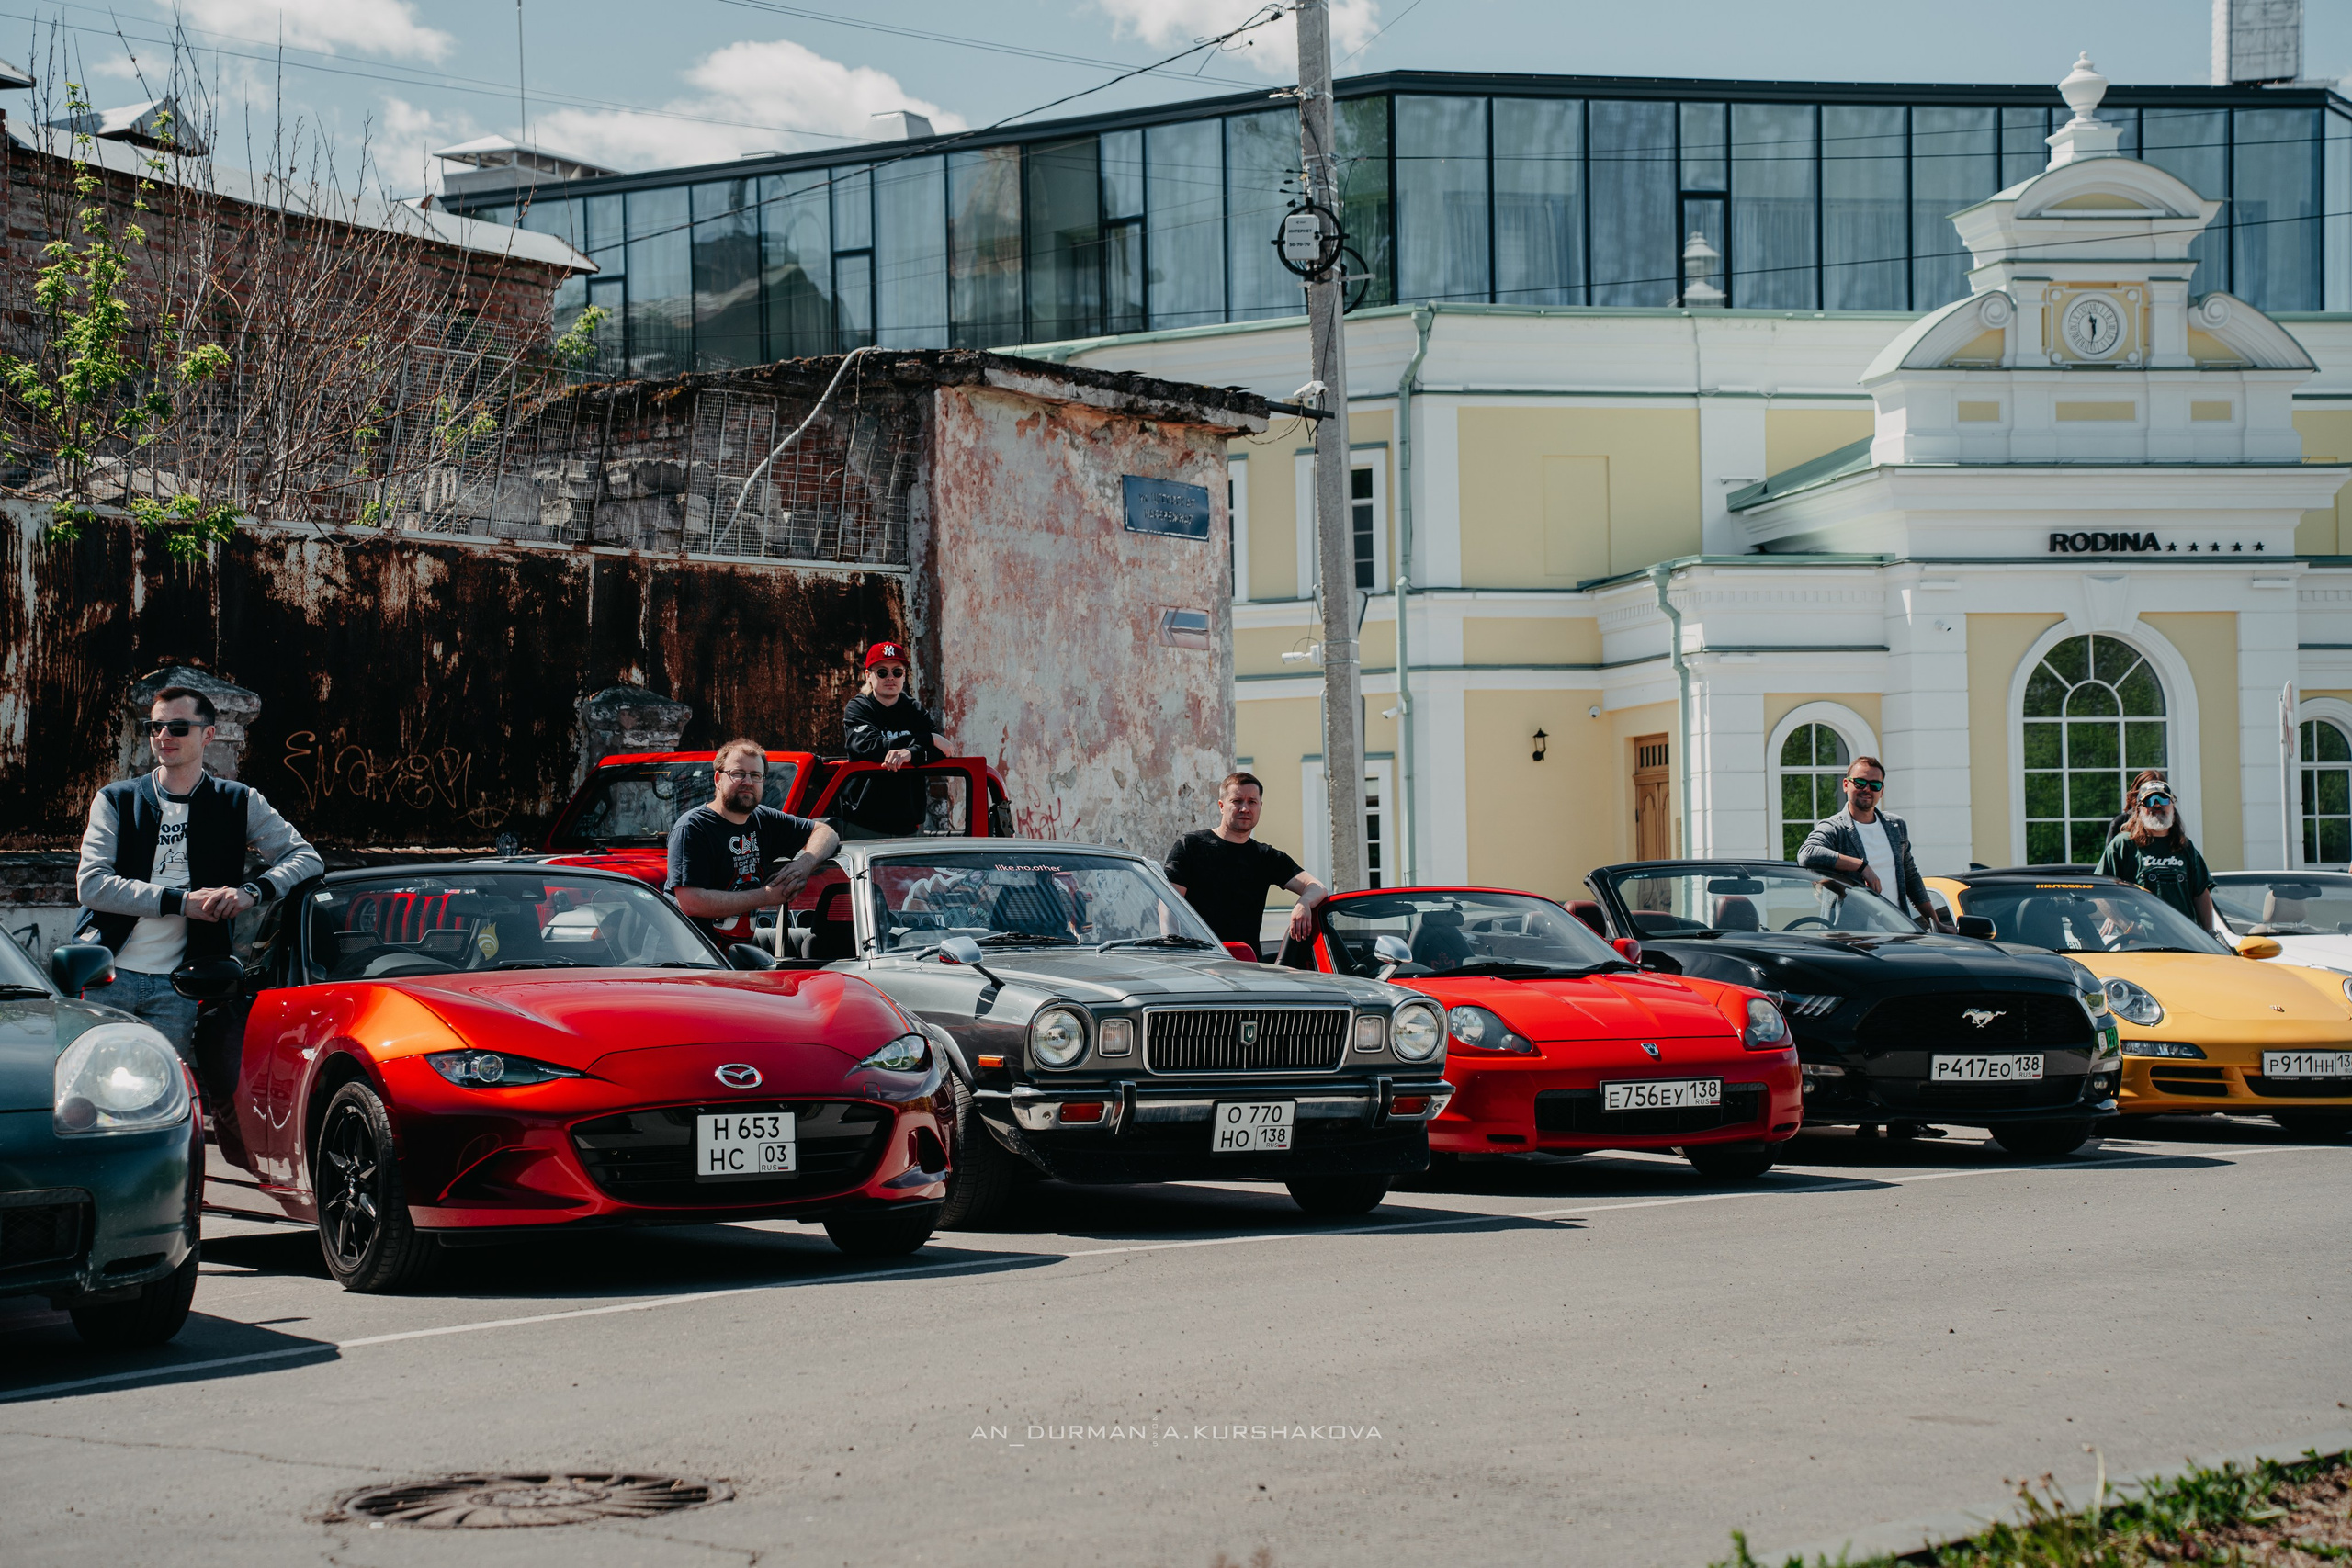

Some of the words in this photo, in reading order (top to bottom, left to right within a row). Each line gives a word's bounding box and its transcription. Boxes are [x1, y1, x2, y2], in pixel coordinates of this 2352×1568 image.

[2049, 532, 2162, 552] RODINA
[2142, 855, 2185, 867] turbo
[2015, 1056, 2040, 1072] 138
[2337, 1055, 2352, 1068] 13
[1690, 1081, 1717, 1099] 138
[1250, 1105, 1283, 1124] 770
[738, 1116, 780, 1139] 653
[1260, 1128, 1286, 1143] 138
[764, 1145, 786, 1163] 03
